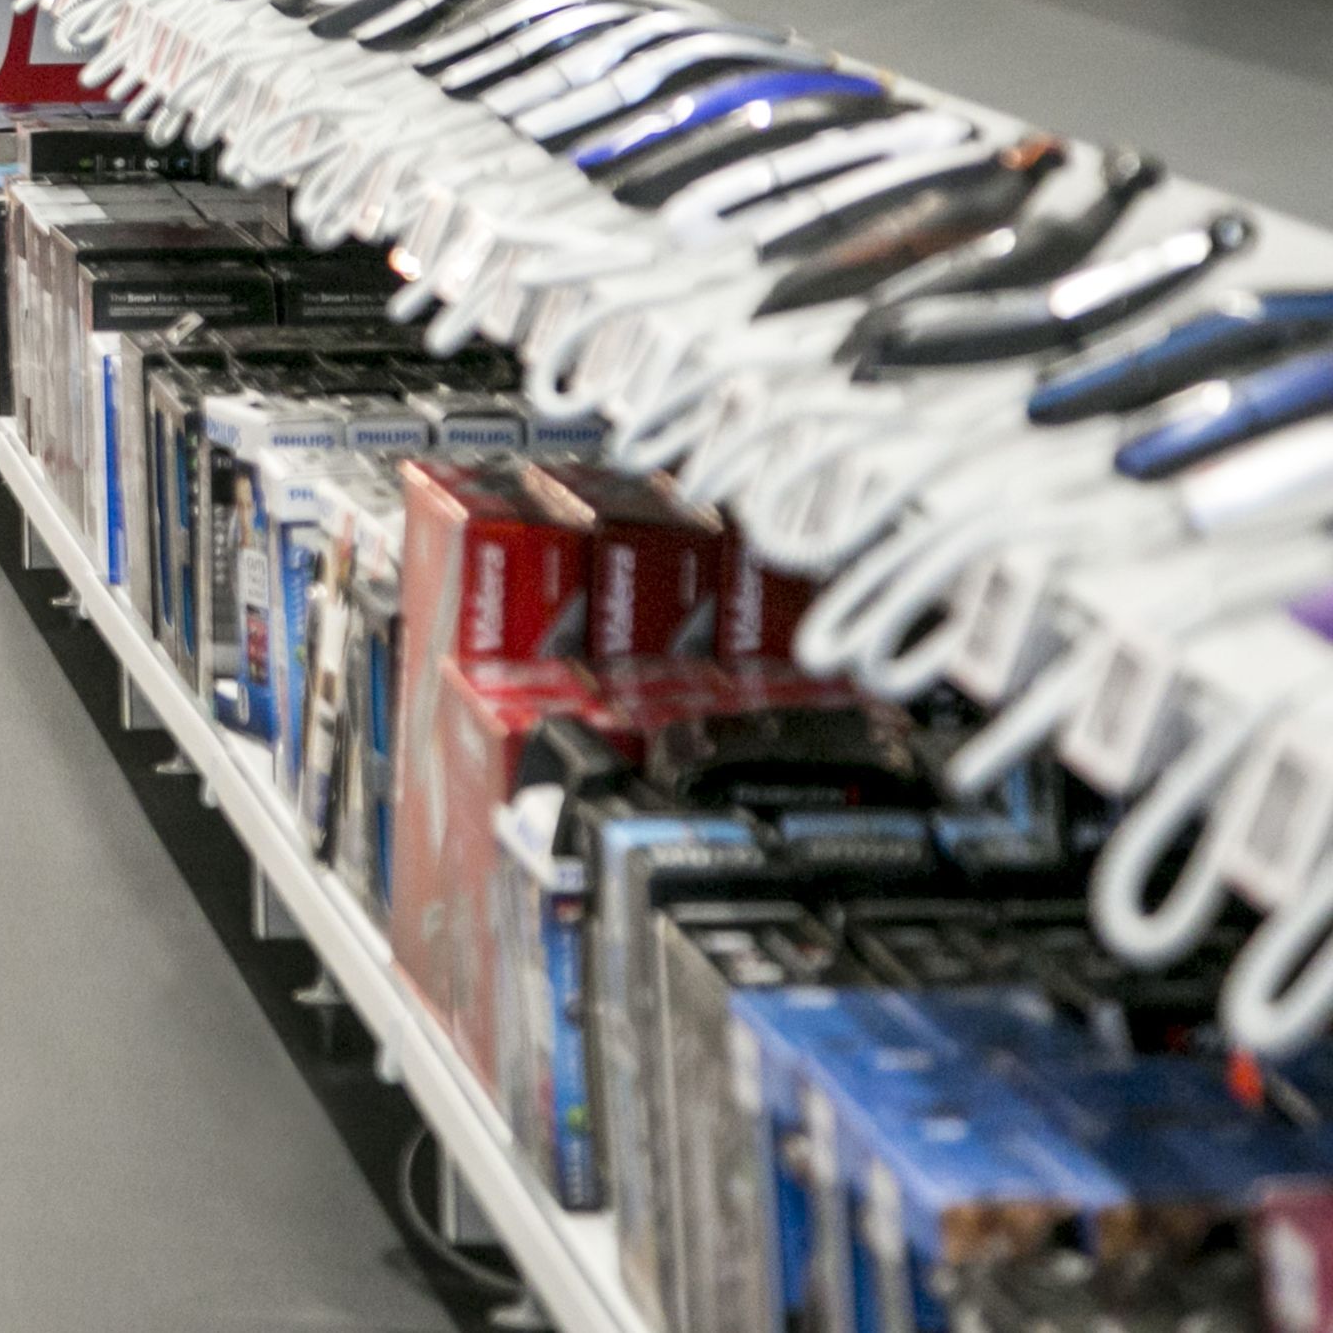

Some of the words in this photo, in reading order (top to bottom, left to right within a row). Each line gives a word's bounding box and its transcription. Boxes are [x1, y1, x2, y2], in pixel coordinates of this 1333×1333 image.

[272, 433, 335, 448] PHILIPS
[357, 430, 421, 445] PHILIPS
[449, 430, 515, 445] PHILIPS
